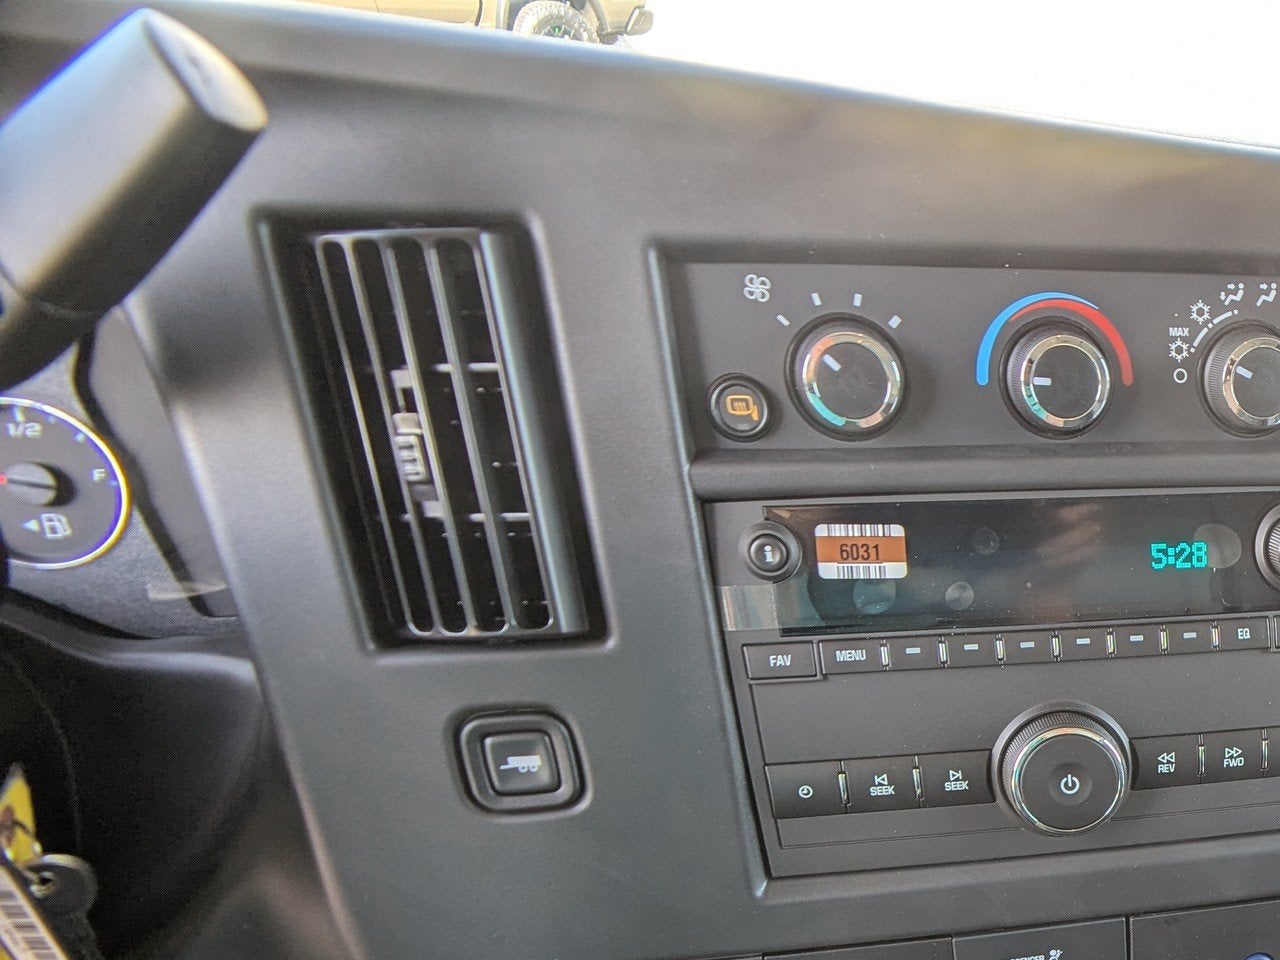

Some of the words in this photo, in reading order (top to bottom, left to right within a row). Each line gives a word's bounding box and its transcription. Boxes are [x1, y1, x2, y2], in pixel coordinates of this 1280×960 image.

[1169, 327, 1189, 337] MAX
[92, 468, 107, 482] F
[839, 543, 881, 561] 6031
[1151, 541, 1208, 569] 5:28
[1237, 628, 1251, 640] EQ
[769, 654, 792, 667] FAV
[835, 649, 867, 661] MENU
[1158, 763, 1176, 773] REV
[1223, 757, 1245, 768] FWD
[870, 785, 895, 796] SEEK
[944, 781, 969, 792] SEEK
